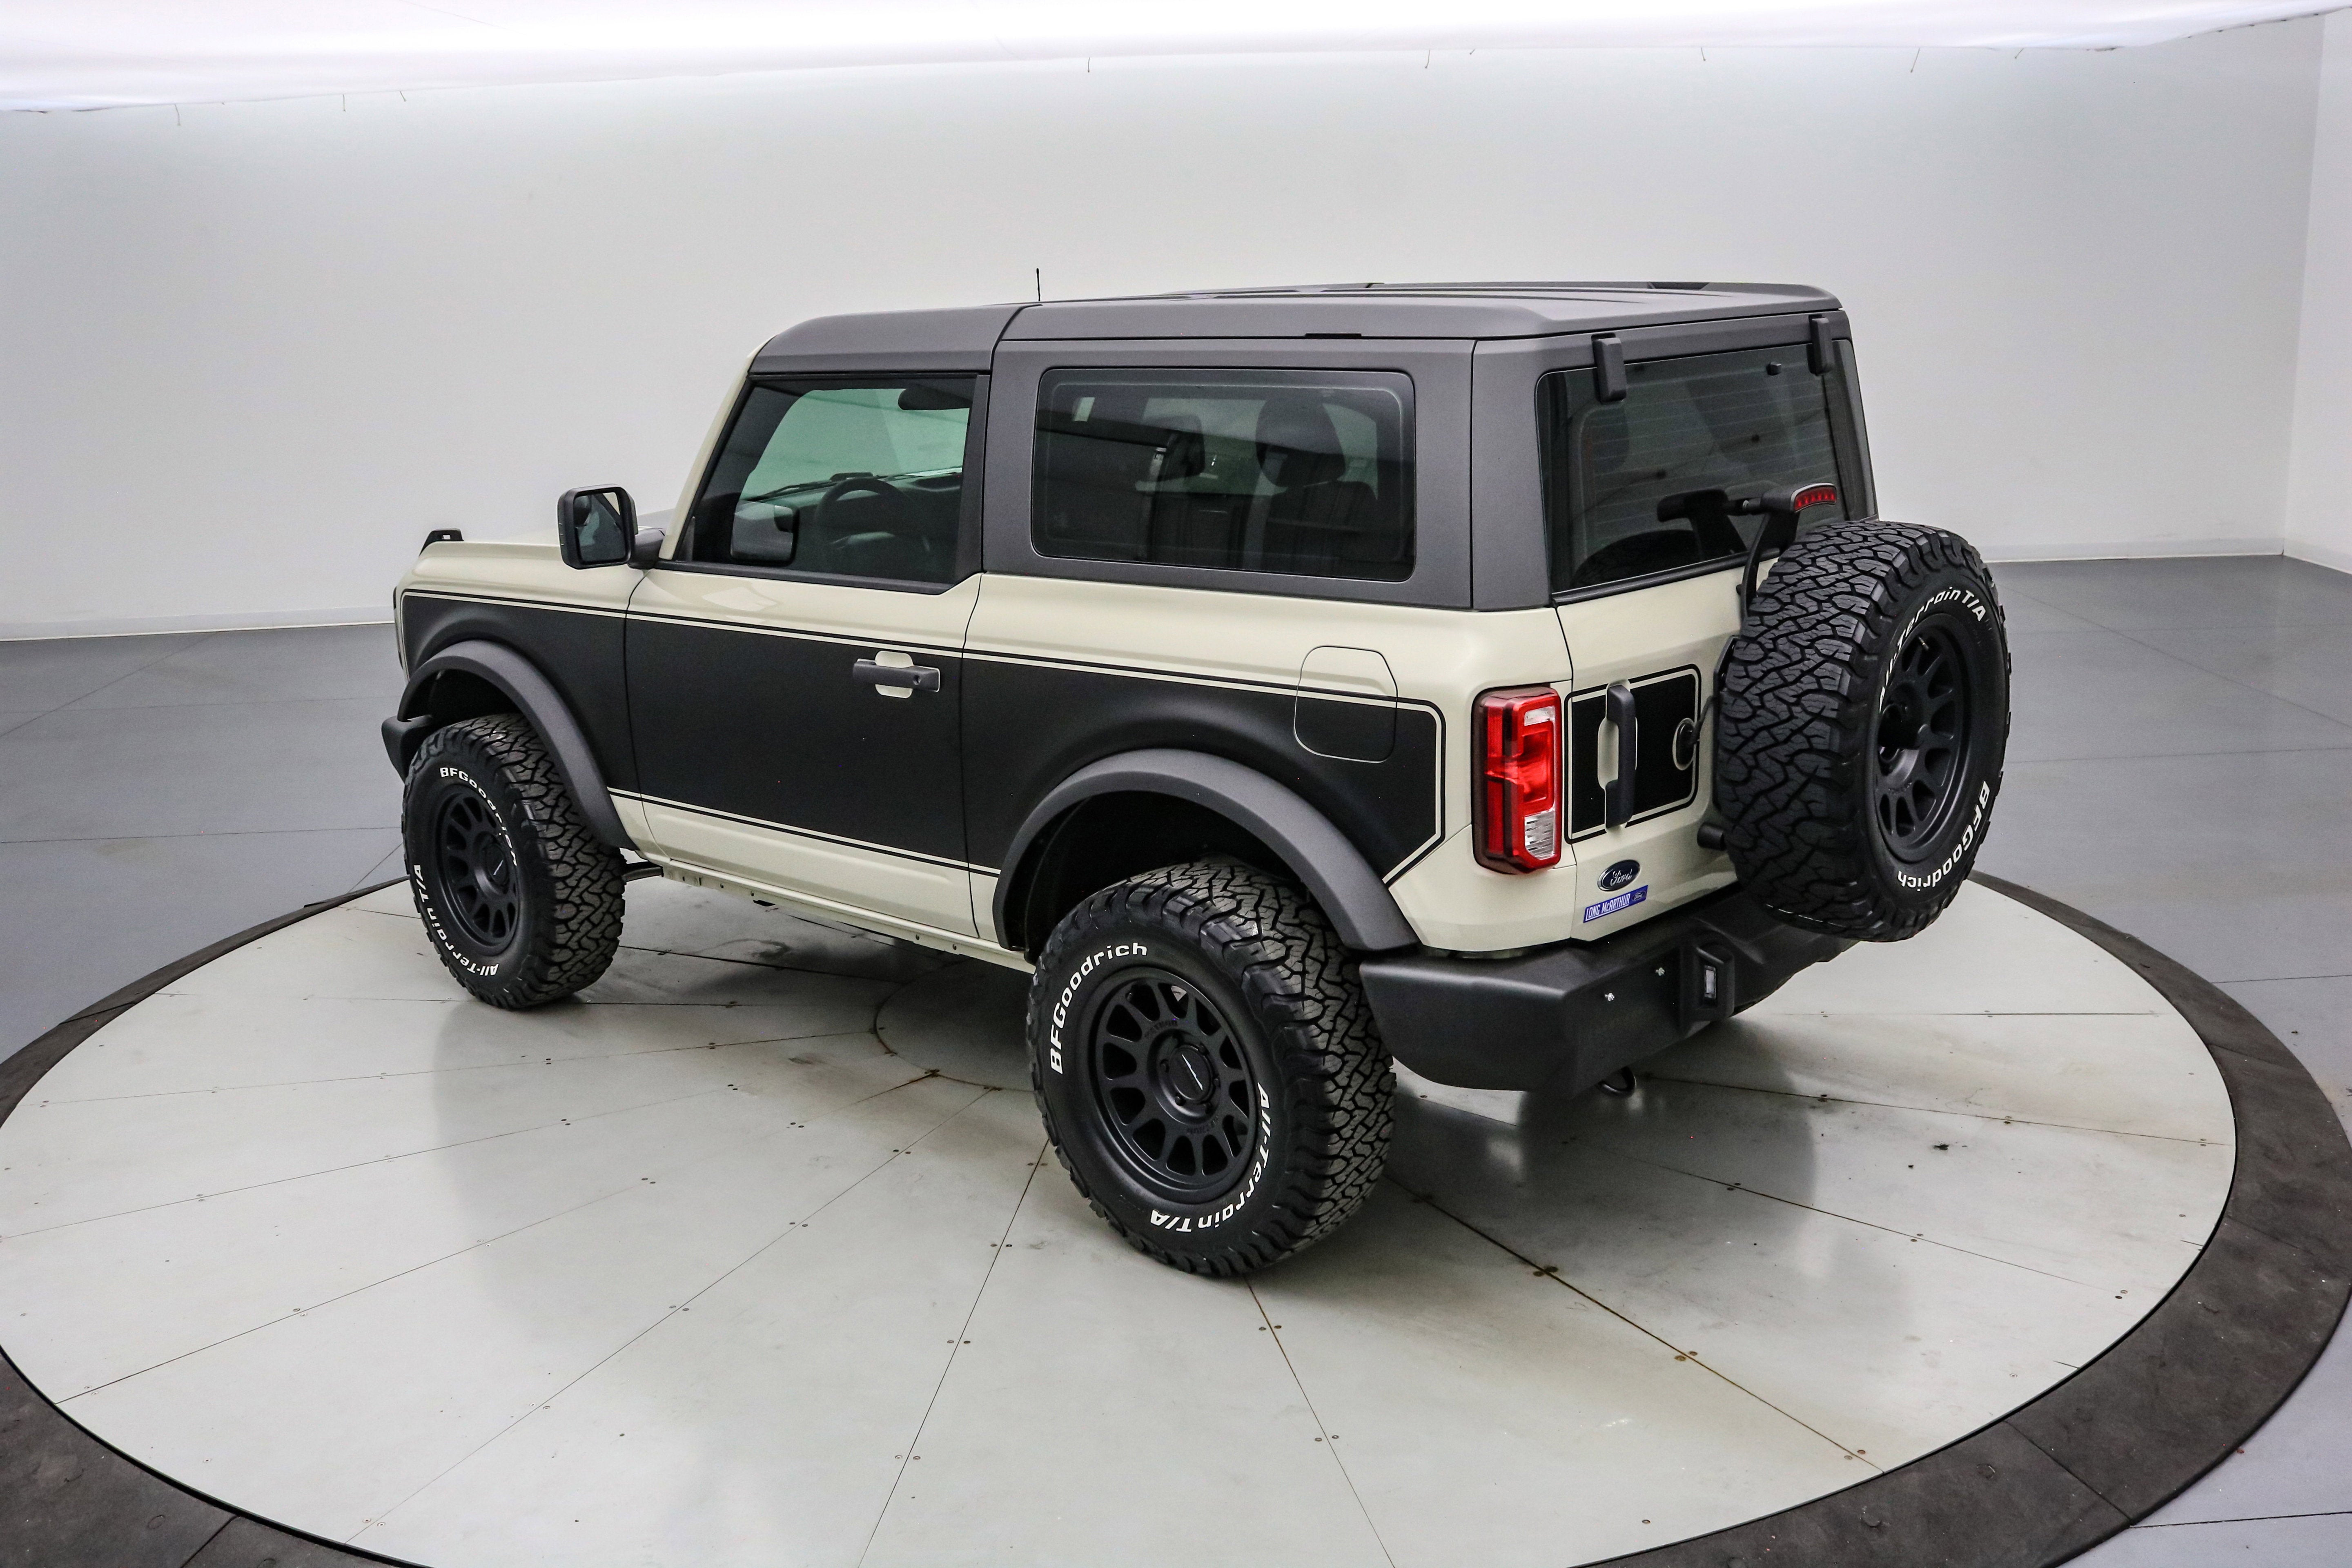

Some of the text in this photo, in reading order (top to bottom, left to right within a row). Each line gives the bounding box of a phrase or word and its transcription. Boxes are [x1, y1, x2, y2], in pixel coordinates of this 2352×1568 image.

[1879, 587, 1986, 713] All-Terrain T/A
[440, 767, 517, 866] BFGoodrich
[1898, 781, 1990, 891] BFGoodrich
[414, 865, 499, 976] All-Terrain T/A
[1585, 904, 1601, 921] LONG
[1610, 868, 1633, 886] Ford
[1050, 942, 1147, 1074] BFGoodrich
[1198, 1082, 1271, 1228] All-Terrain
[1150, 1209, 1192, 1232] T/A
